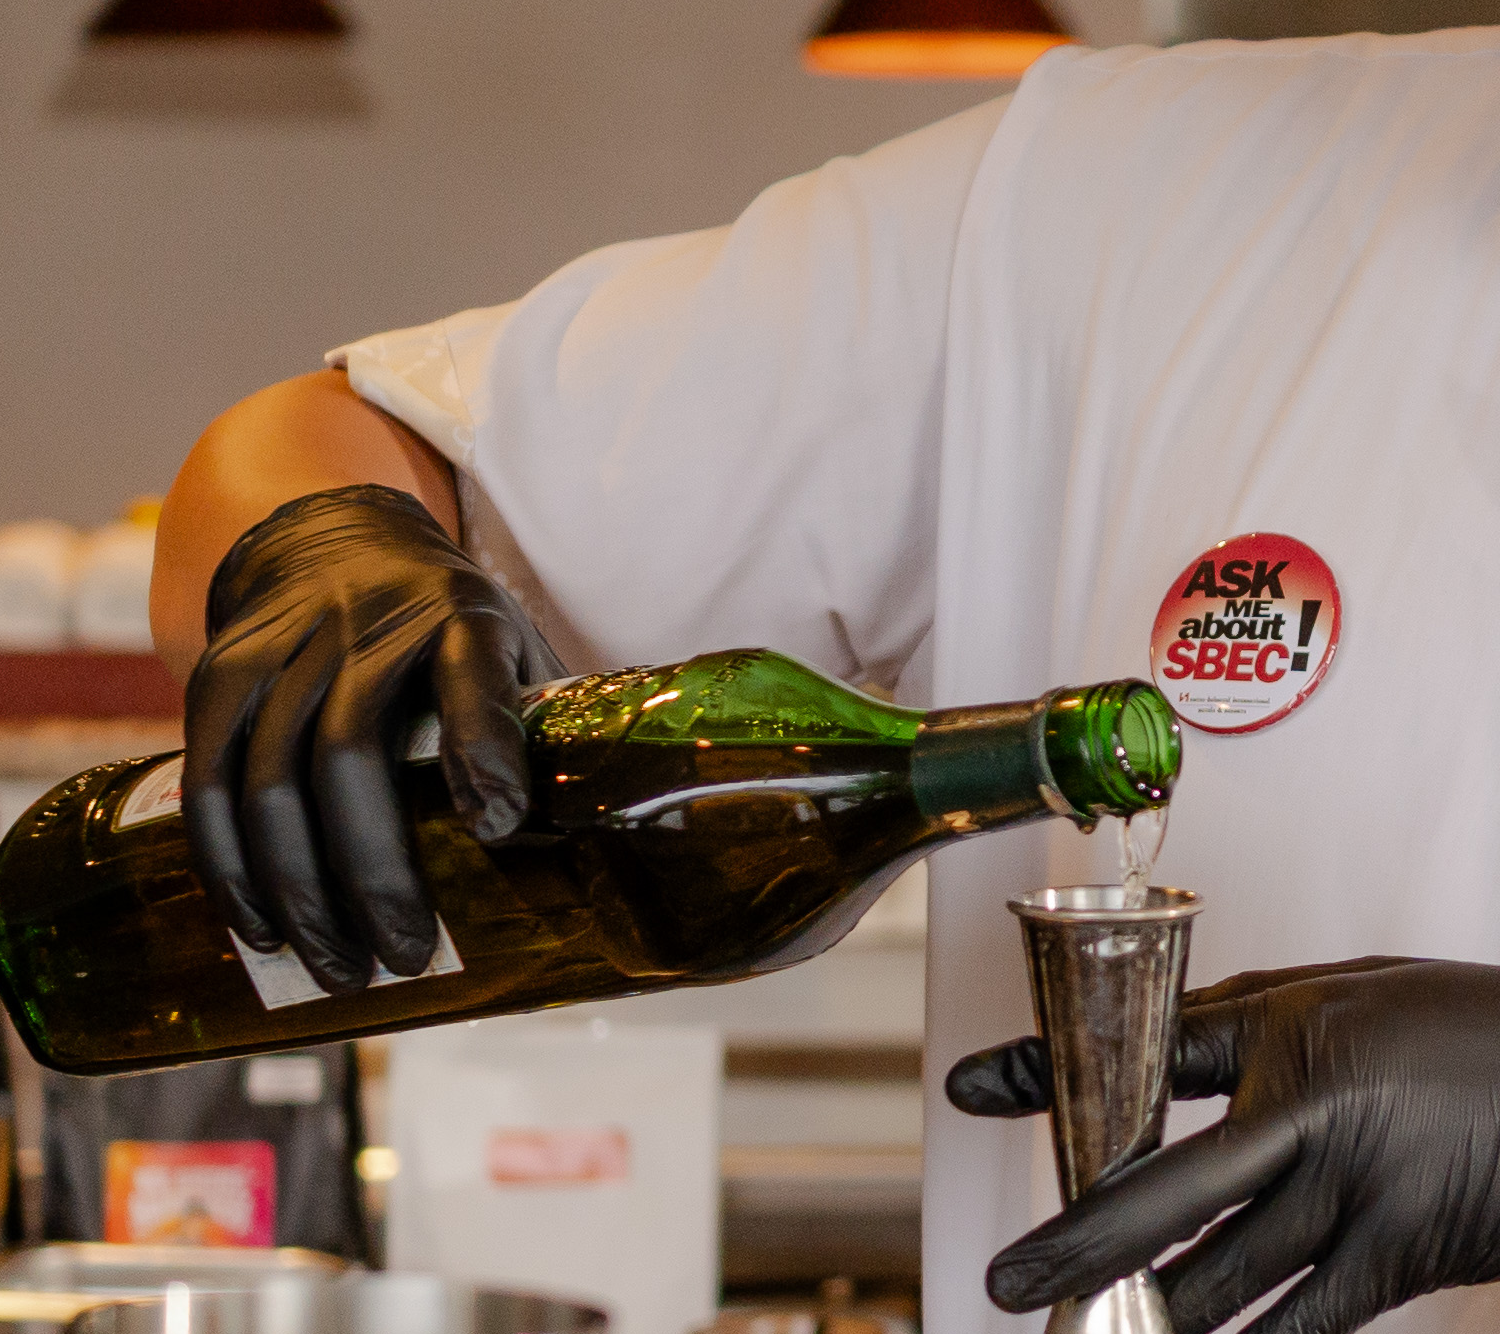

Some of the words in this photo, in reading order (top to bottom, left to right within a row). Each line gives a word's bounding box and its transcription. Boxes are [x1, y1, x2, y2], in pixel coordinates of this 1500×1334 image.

[1182, 559, 1290, 599] ASK
[1223, 599, 1274, 618] ME
[1178, 612, 1286, 641] about
[1162, 639, 1290, 683] SBEC
